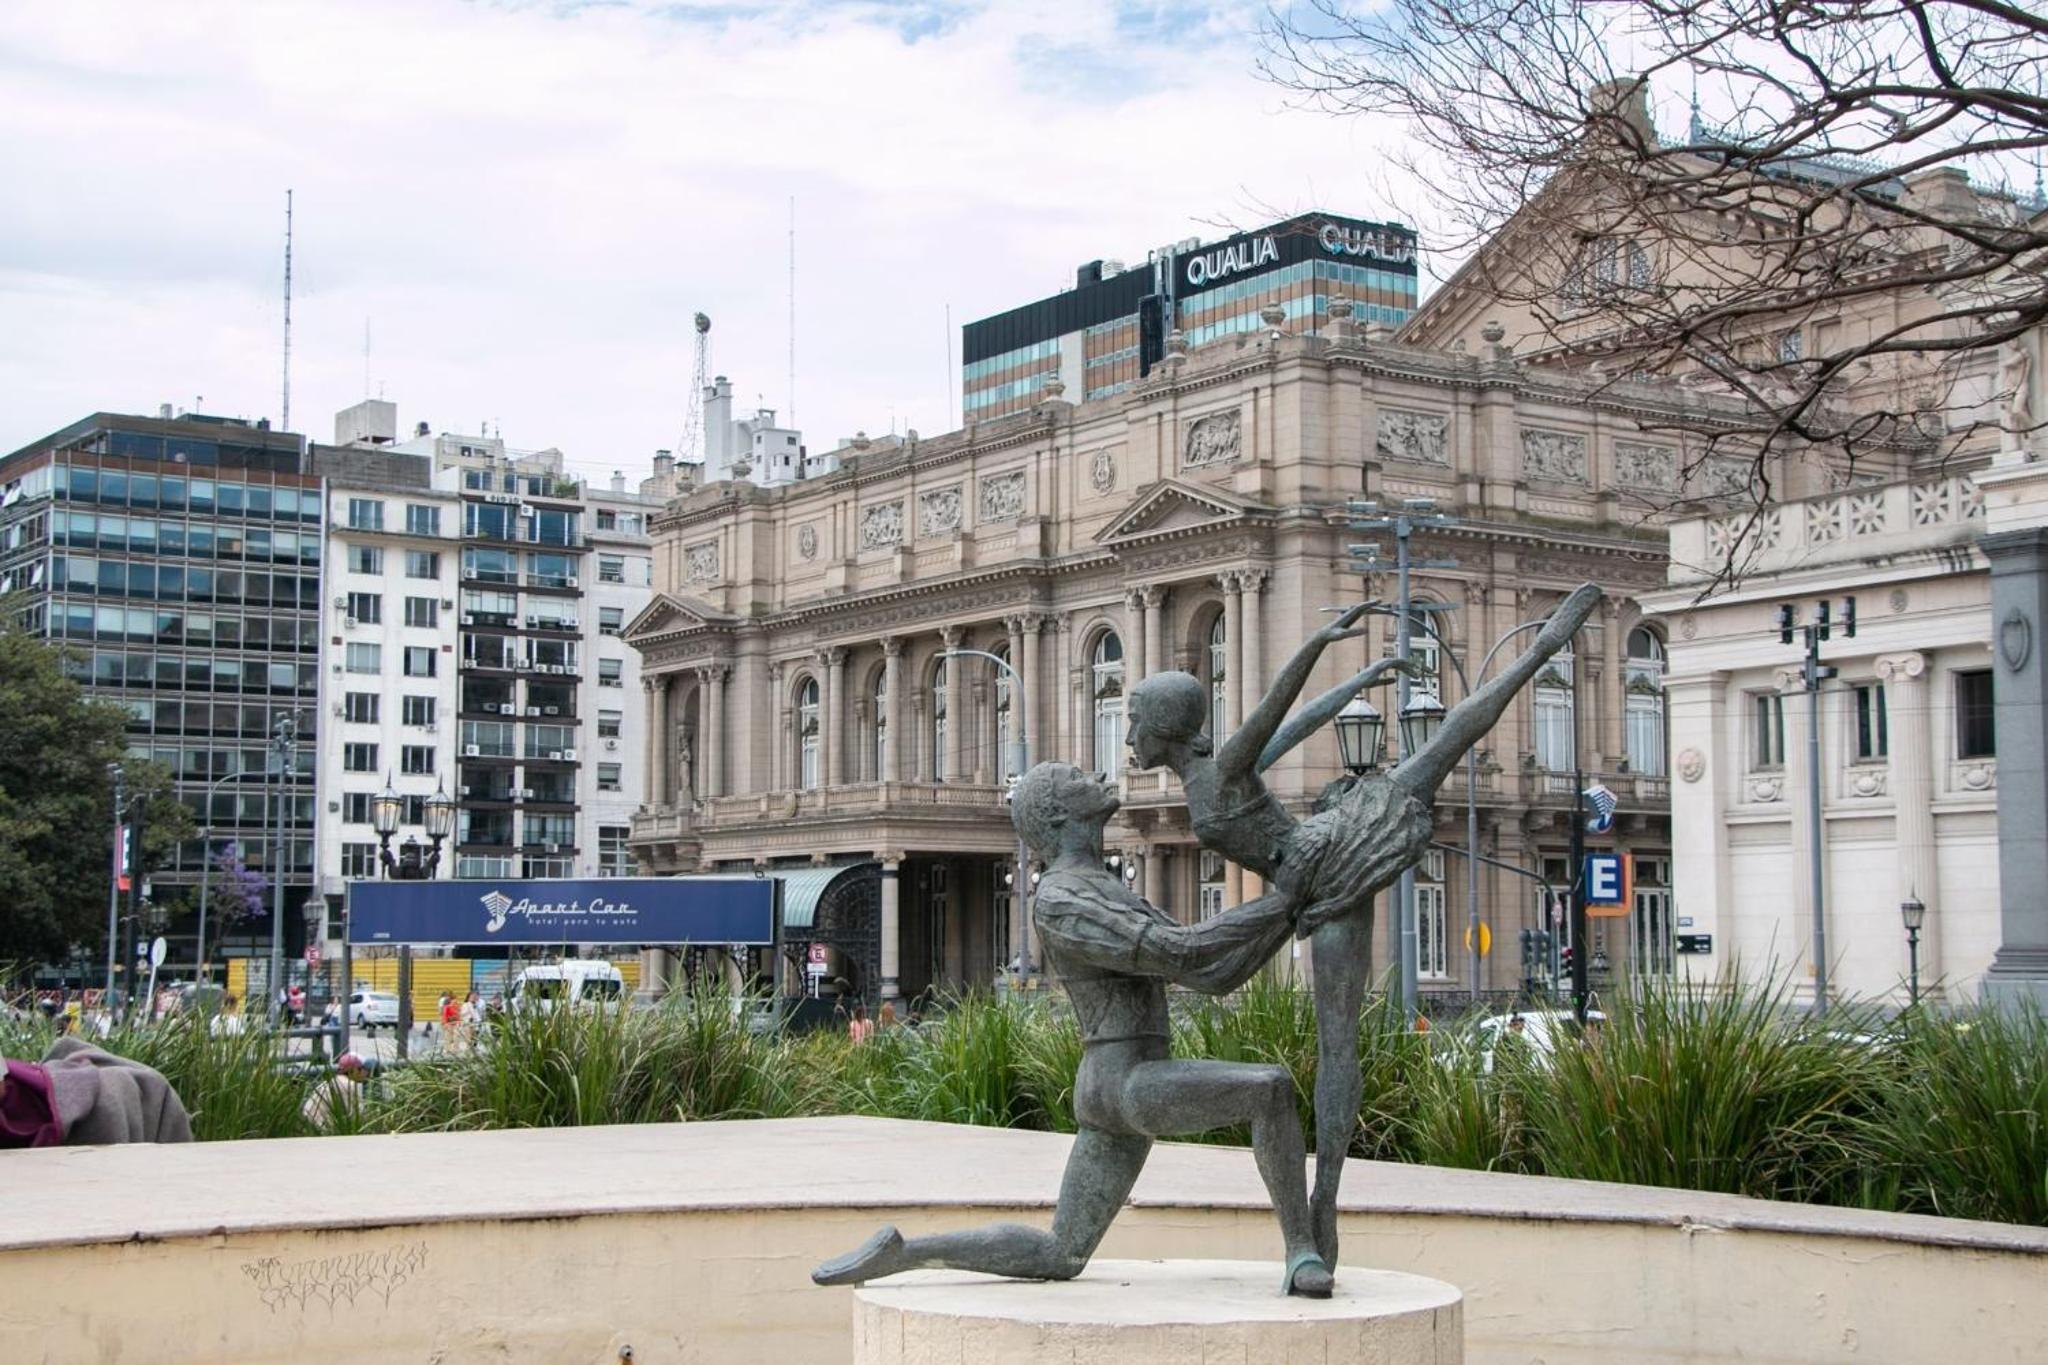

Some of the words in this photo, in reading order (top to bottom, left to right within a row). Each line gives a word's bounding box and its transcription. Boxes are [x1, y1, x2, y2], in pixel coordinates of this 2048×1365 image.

[1187, 234, 1280, 286] QUALIA
[1319, 224, 1417, 265] QUALIA
[1592, 859, 1617, 898] E
[509, 898, 587, 918] Apart
[589, 898, 638, 914] Car
